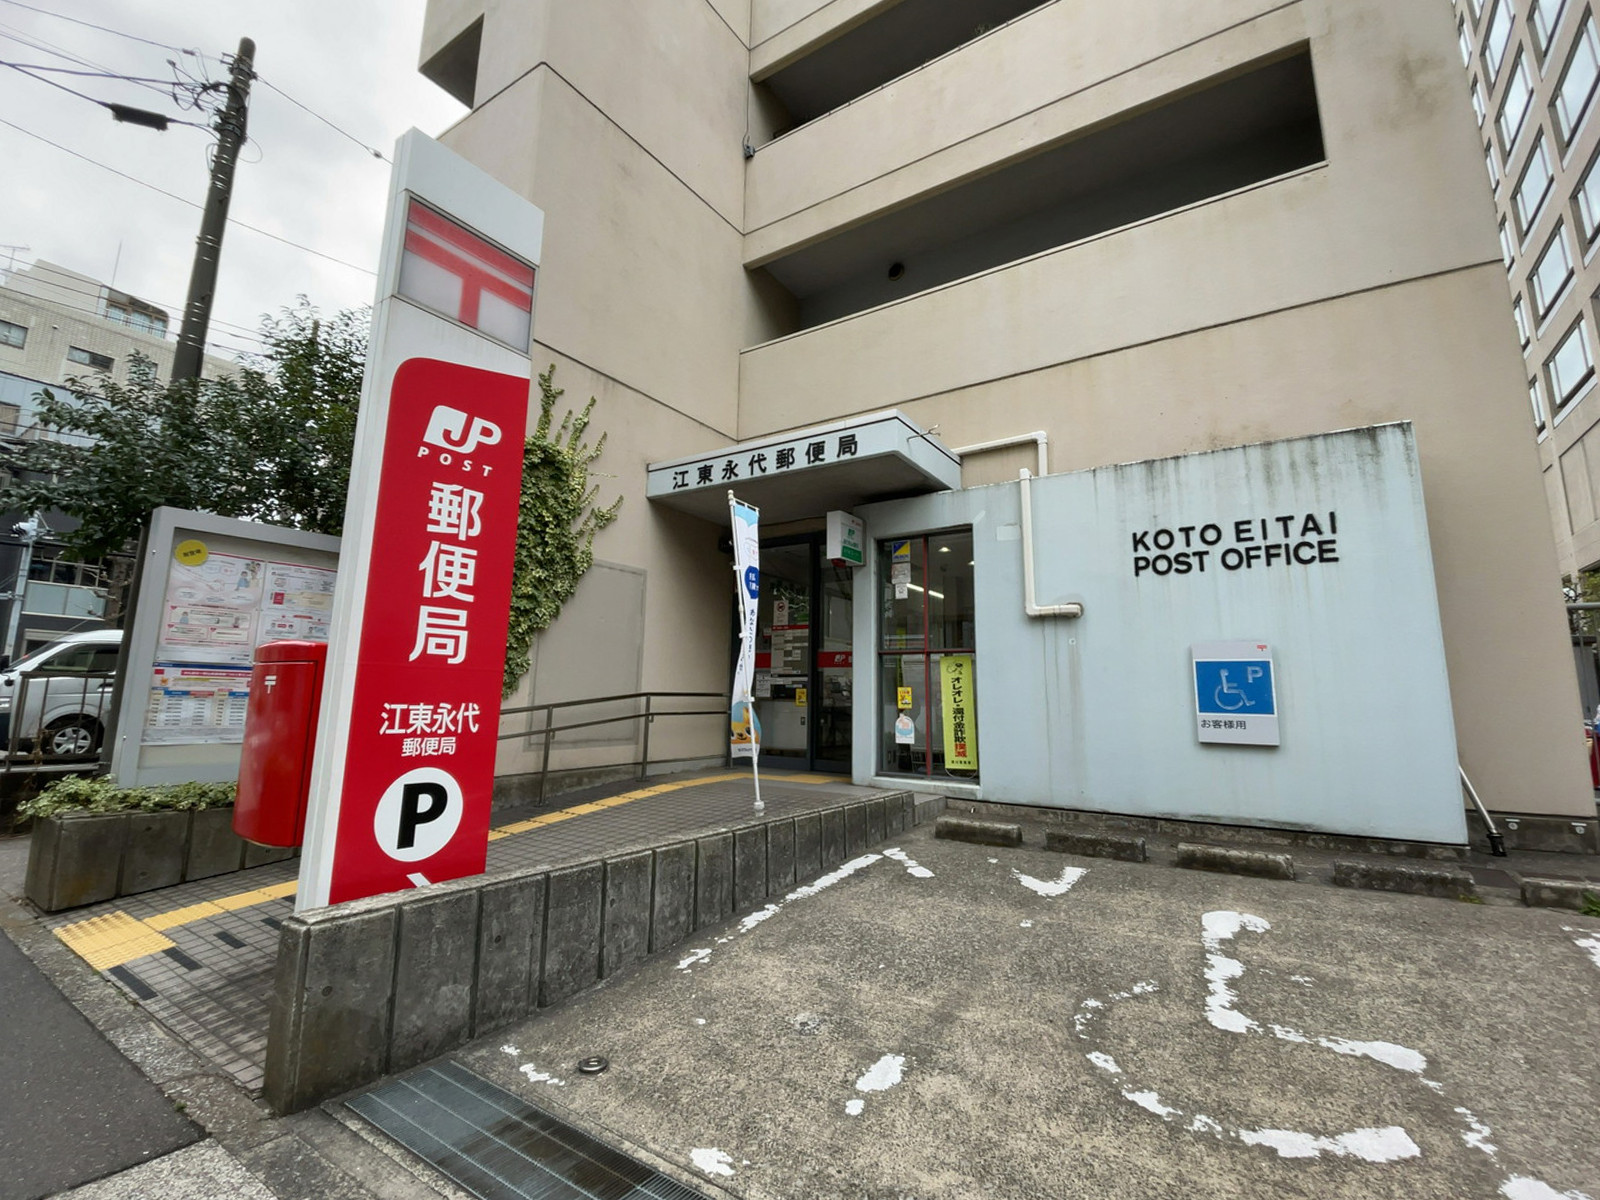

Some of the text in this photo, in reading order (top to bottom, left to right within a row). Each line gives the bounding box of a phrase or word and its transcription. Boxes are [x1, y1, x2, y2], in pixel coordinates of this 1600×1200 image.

[417, 446, 493, 477] POST
[672, 433, 858, 490] 江東永代郵便局
[1132, 511, 1338, 552] KOTO EITAI
[408, 481, 484, 664] 郵便局
[1134, 539, 1339, 577] POST OFFICE
[1247, 666, 1263, 683] P
[379, 702, 480, 736] 江東永代
[1200, 719, 1247, 730] お客様用
[400, 736, 456, 757] 郵便局
[396, 782, 448, 850] P
